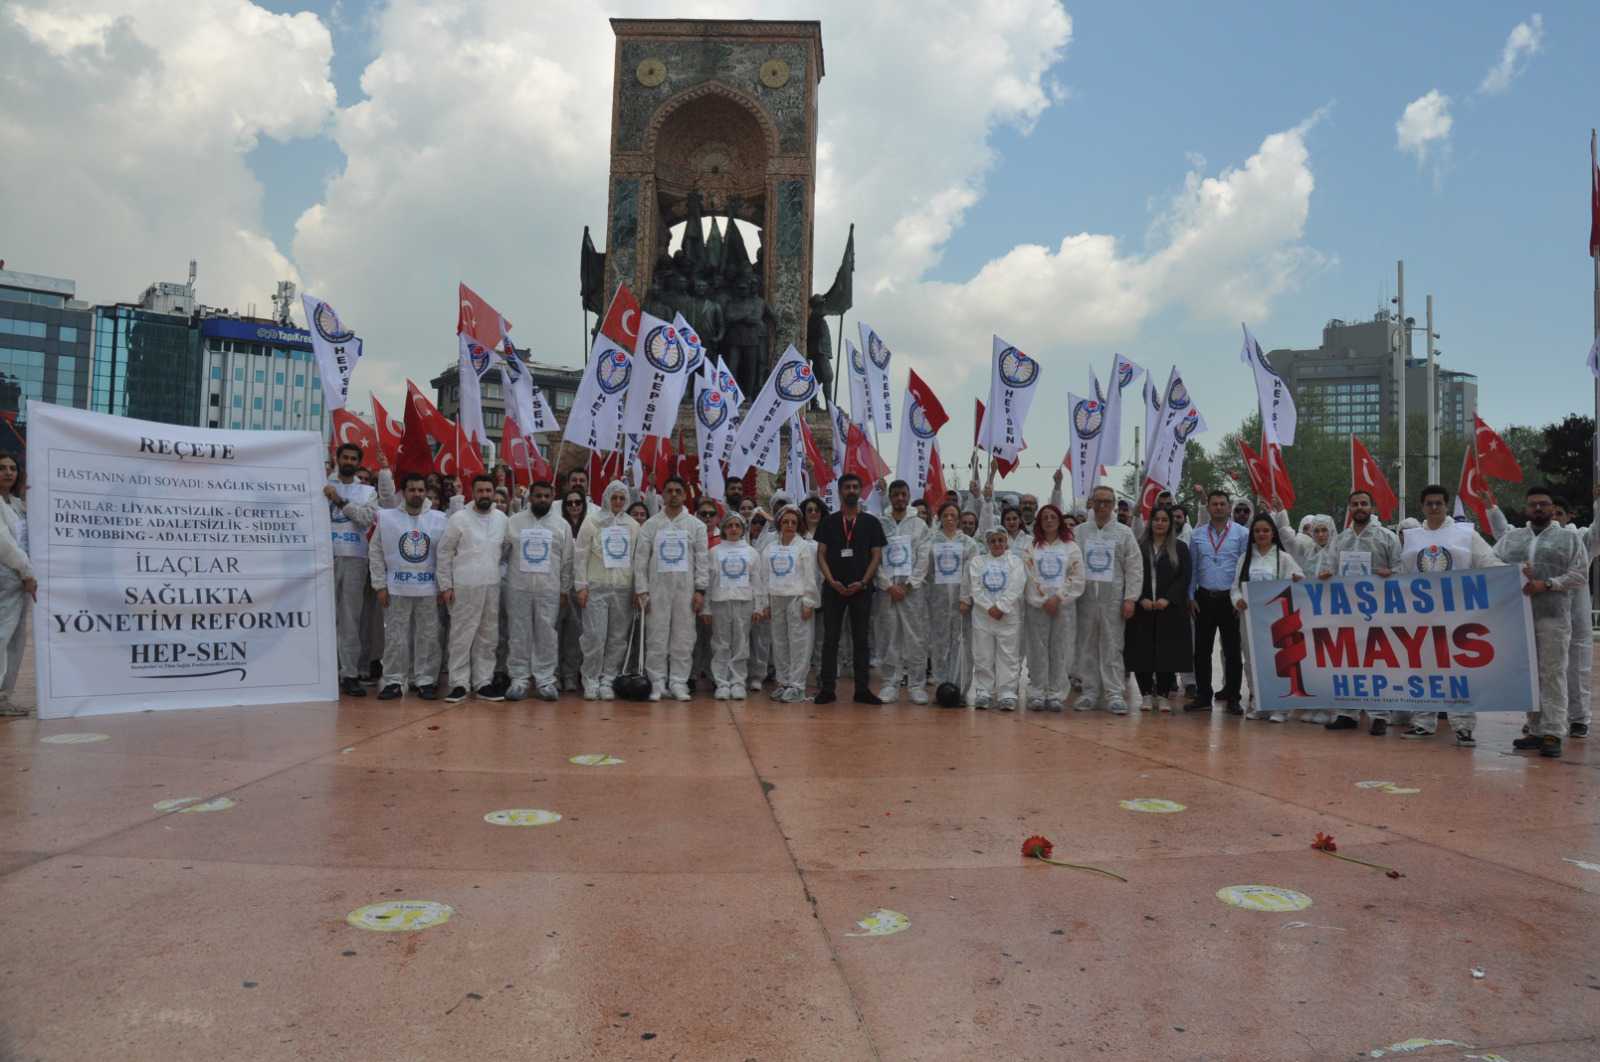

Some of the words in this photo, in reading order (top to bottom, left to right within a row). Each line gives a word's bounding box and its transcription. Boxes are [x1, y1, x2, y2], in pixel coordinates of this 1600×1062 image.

[139, 436, 236, 460] REÇETE
[56, 467, 125, 483] HASTANIN
[128, 474, 152, 486] ADI
[207, 476, 254, 491] SAĞLIK
[257, 480, 306, 493] SİSTEMİ
[121, 501, 224, 516] LİYAKATSİZLİK
[54, 511, 144, 527] DİRMEMEDE
[146, 517, 242, 532] ADALETSİZLİK
[54, 527, 74, 538] VE
[155, 531, 229, 544] ADALETSİZ
[231, 531, 308, 545] TEMSİLİYET
[135, 551, 240, 577] İLAÇLAR
[124, 583, 254, 605] SAĞLIKTA
[1304, 574, 1490, 622] YAŞASIN
[54, 609, 182, 633] YÖNETİM
[191, 611, 312, 632] REFORMU
[130, 641, 248, 664] HEP-SEN
[1312, 622, 1496, 669] MAYIS
[1333, 674, 1470, 699] HEP-SEN
